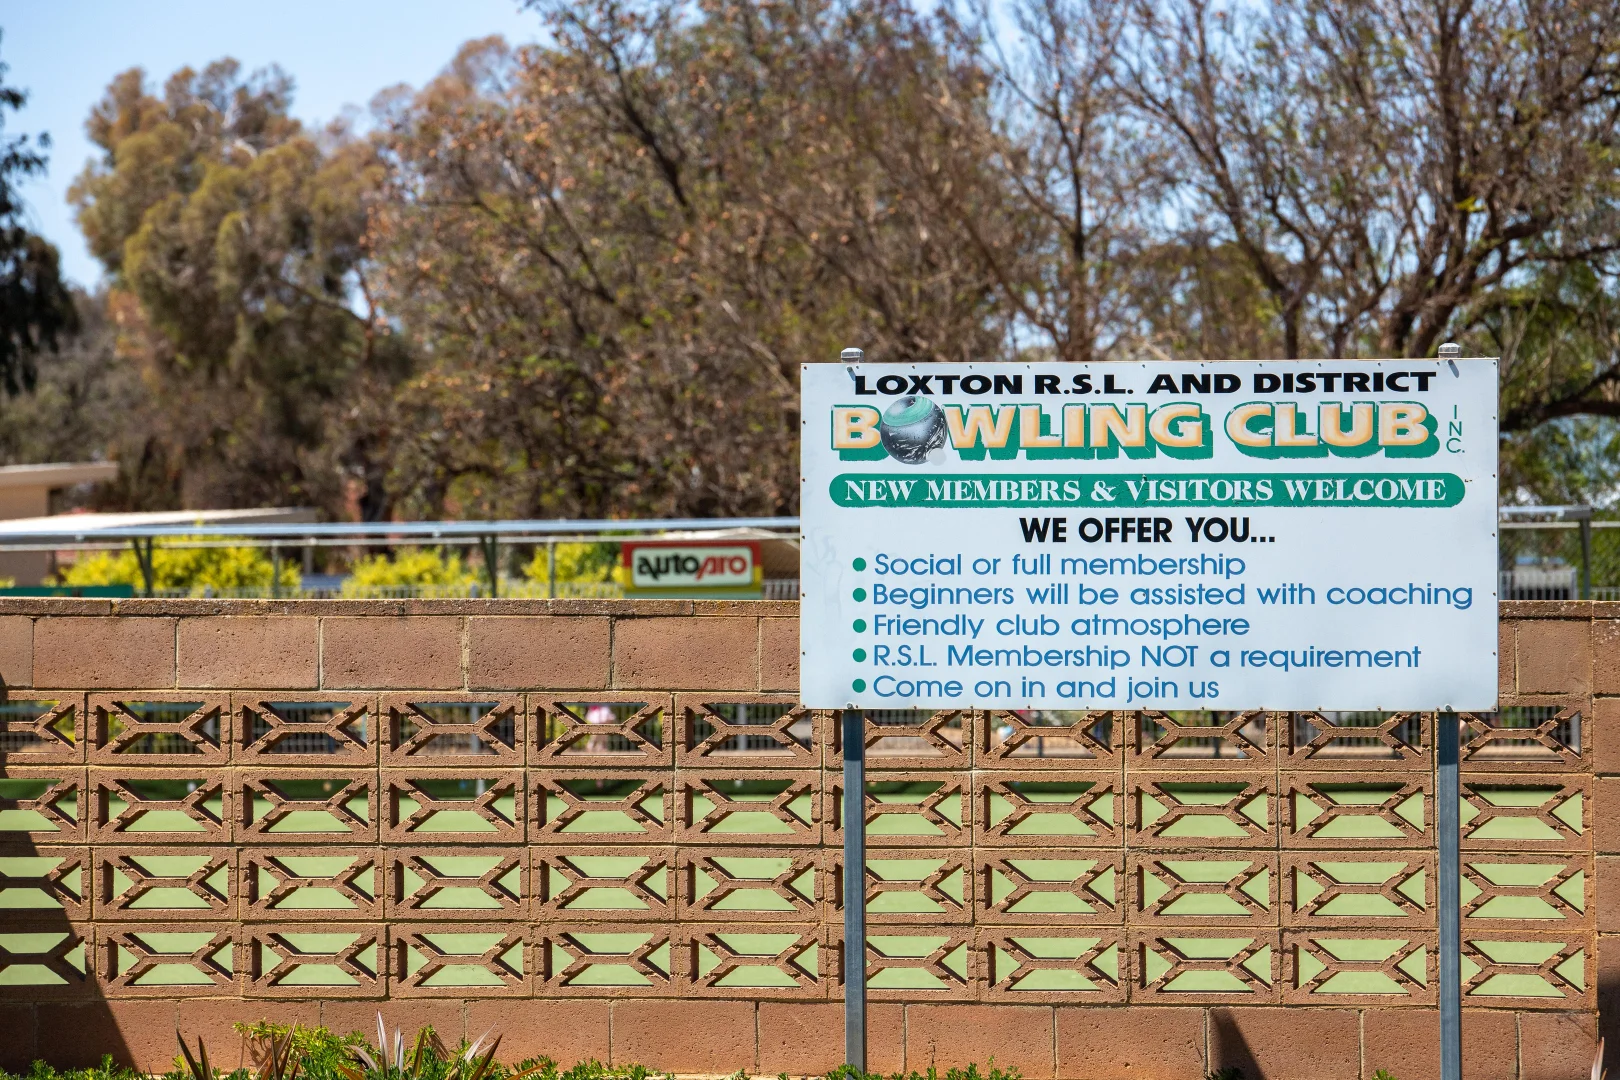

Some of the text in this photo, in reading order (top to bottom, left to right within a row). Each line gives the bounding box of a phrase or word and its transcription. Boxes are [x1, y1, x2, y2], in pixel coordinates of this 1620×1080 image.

[855, 372, 1437, 395] LOXTON R.S.L. AND DISTRICT
[1224, 401, 1440, 459] CLUB
[1446, 404, 1465, 453] INC.
[844, 478, 1447, 501] NEW MEMBERS & VISITORS WELCOME
[1019, 517, 1276, 543] WE OFFER YOU...
[874, 553, 1246, 579] Social or full membership
[873, 583, 1473, 610] Beginners will be assisted with coaching
[873, 613, 1250, 640] Friendly club atmosphere
[873, 644, 1422, 673] R.S.L. Membership NOT a requirement
[873, 675, 1220, 703] Come on in and join us
